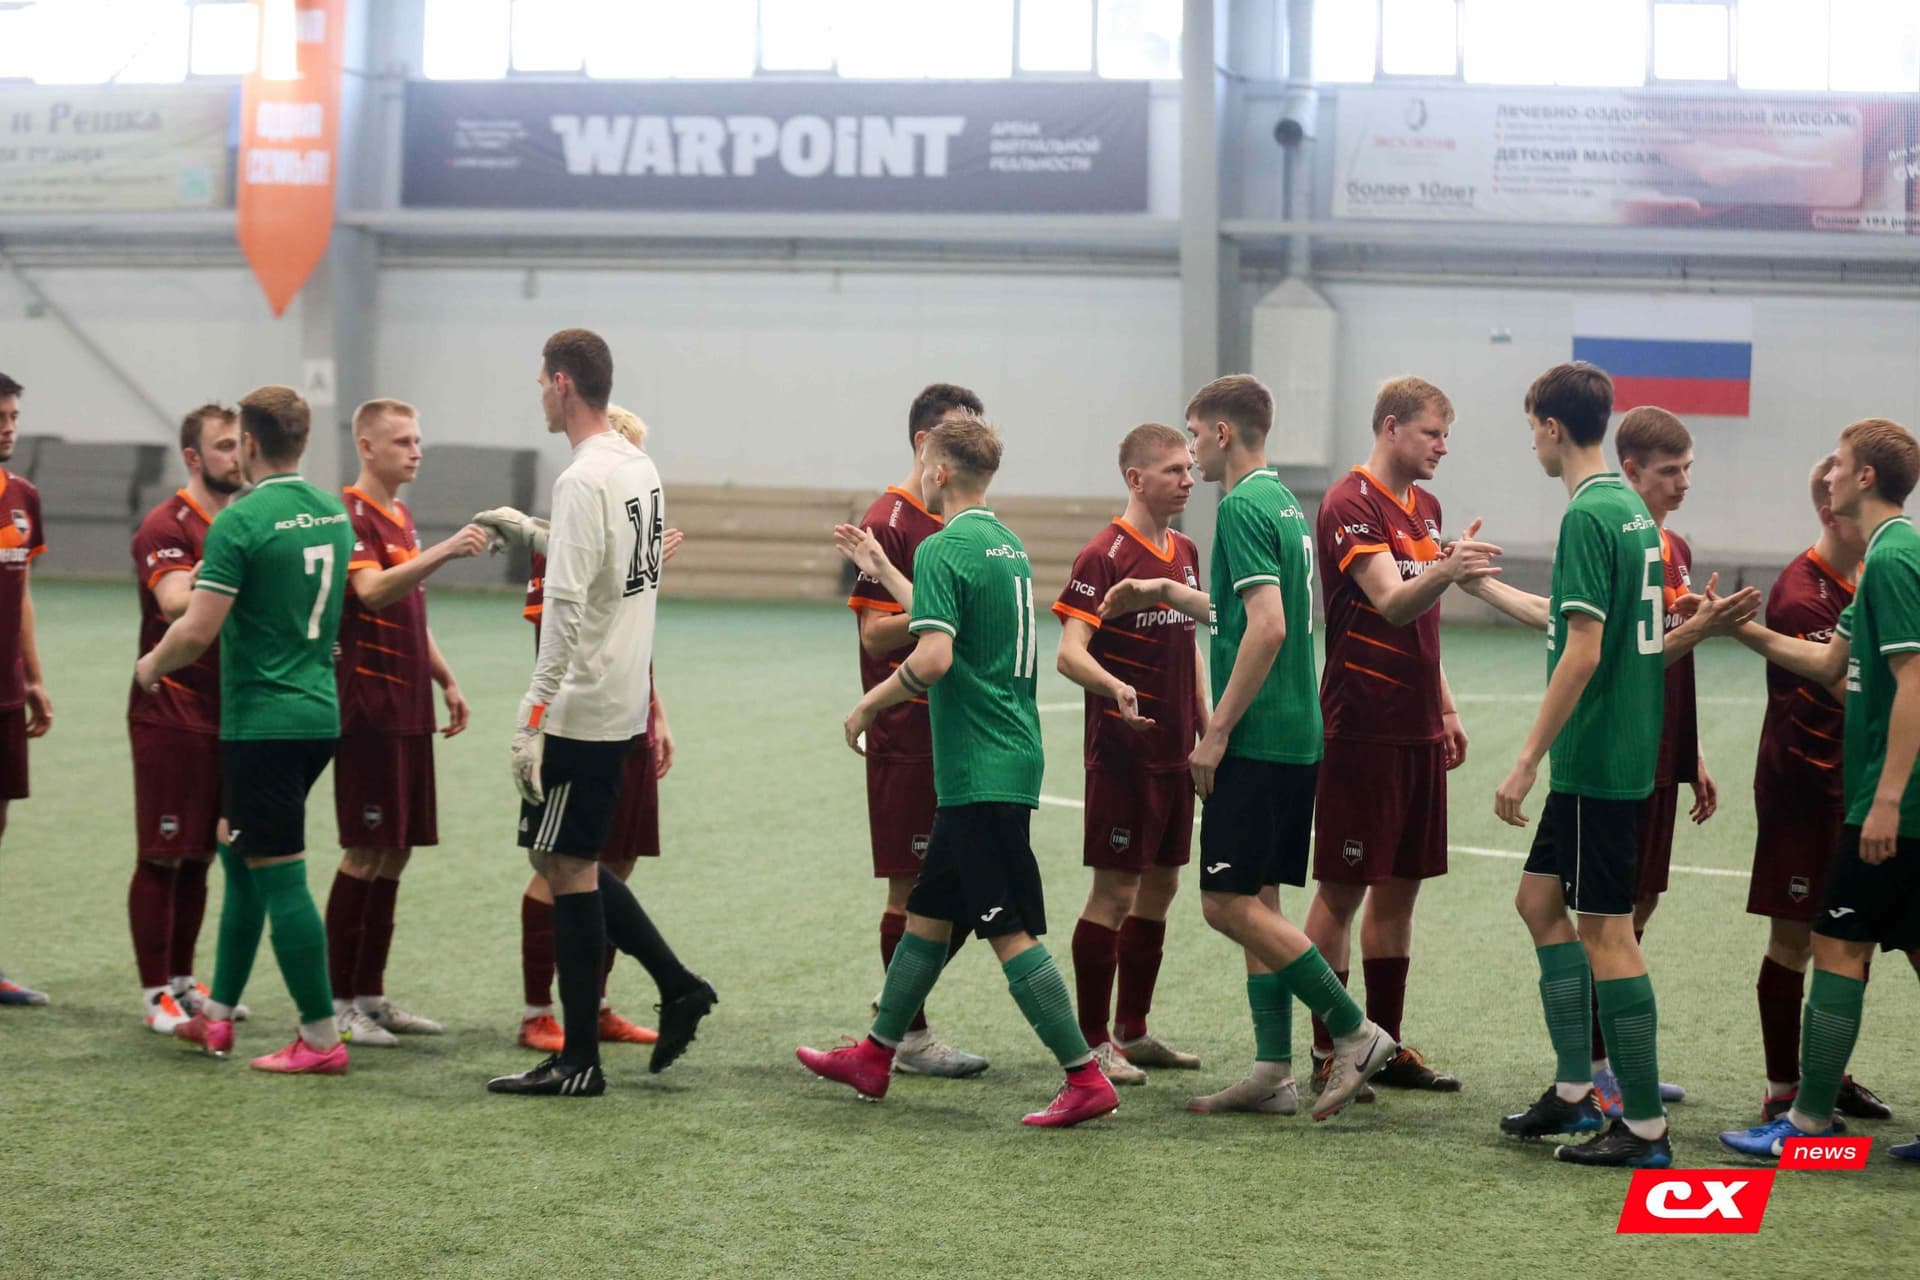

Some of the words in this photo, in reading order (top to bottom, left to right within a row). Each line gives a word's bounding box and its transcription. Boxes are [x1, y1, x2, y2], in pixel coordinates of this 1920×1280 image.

[47, 103, 162, 134] Решка
[1495, 148, 1577, 163] ДЕТСКИЙ
[1346, 178, 1411, 200] более
[623, 487, 662, 599] 16
[302, 543, 335, 640] 7
[1069, 579, 1097, 598] ПСБ
[1637, 547, 1664, 655] 5
[1014, 575, 1037, 679] 11
